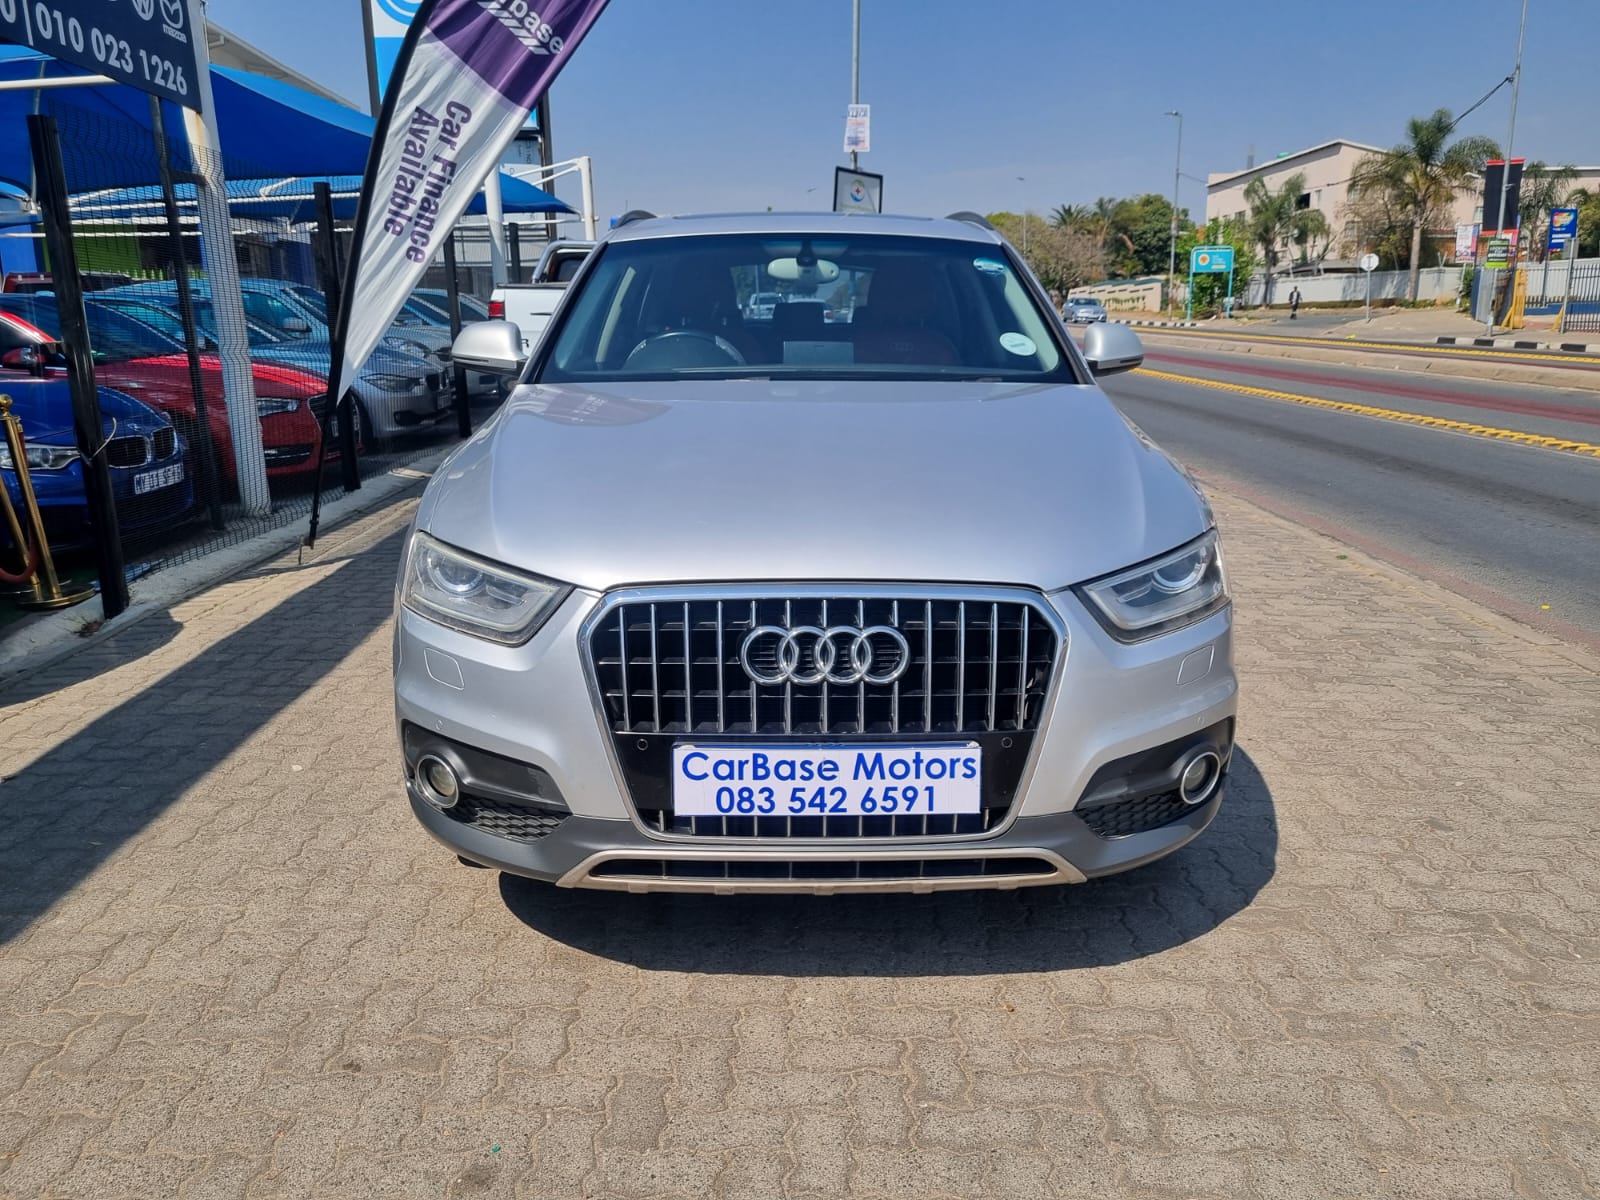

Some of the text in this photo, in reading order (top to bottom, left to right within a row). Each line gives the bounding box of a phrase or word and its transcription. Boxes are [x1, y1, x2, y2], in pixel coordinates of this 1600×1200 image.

[35, 2, 187, 95] 010 023 1226
[506, 0, 563, 54] base
[384, 106, 440, 237] Available
[406, 100, 472, 263] Car Finance
[681, 751, 977, 781] CarBase Motors
[716, 785, 935, 813] 083 542 6591
